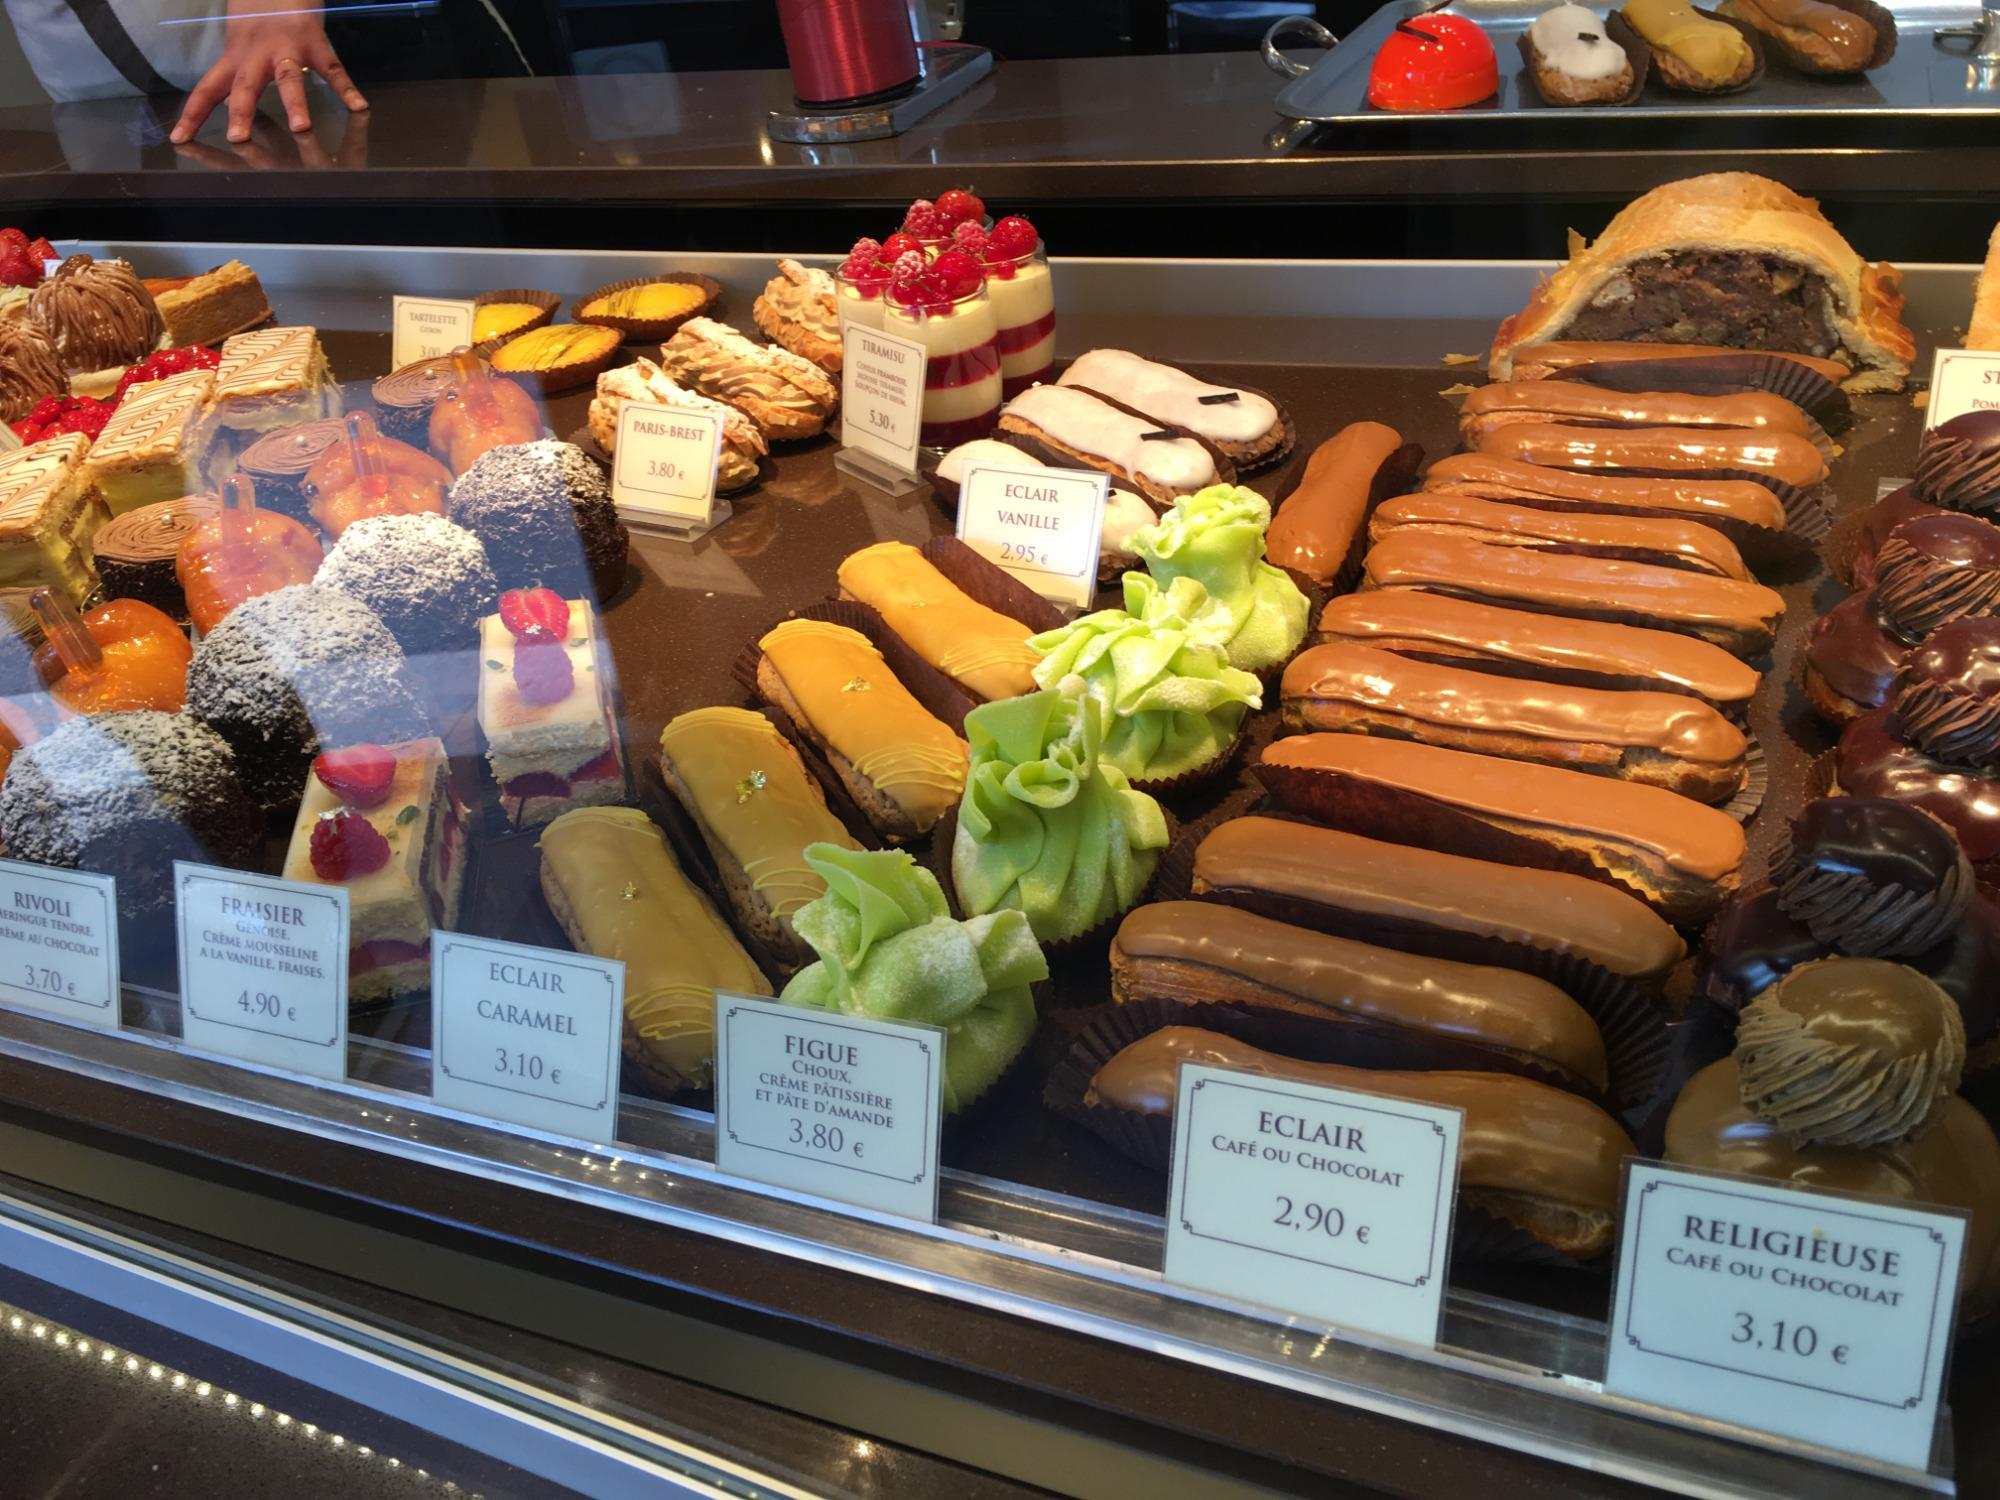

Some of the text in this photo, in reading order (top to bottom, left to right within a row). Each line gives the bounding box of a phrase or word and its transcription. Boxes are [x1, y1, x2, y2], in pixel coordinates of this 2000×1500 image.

[410, 312, 457, 325] TARTELETTE
[419, 345, 441, 358] 300
[862, 339, 905, 364] TIRAMISU
[633, 420, 705, 441] PARIS-BREST
[891, 423, 896, 433] €
[678, 470, 686, 480] €
[1005, 484, 1059, 503] ECLAIR
[997, 510, 1060, 530] VANILLE
[1041, 554, 1049, 565] €
[14, 891, 71, 917] RIVOLI
[221, 896, 305, 927] FRAISIER
[28, 934, 42, 945] AU
[44, 937, 100, 957] CHOCOLAT
[210, 948, 223, 960] LA
[244, 939, 319, 962] MOUSSELINE
[68, 982, 76, 996] €
[489, 962, 566, 994] ECLAIR
[288, 1007, 297, 1022] €
[477, 1000, 578, 1036] CARAMEL
[784, 1034, 858, 1067] FIGUE
[495, 1048, 561, 1085] 3,10 €
[792, 1060, 852, 1084] CHOUX,
[814, 1081, 893, 1110] PÂTISSIÈRE
[755, 1088, 894, 1129] ET PÂTE D'AMANDE
[789, 1118, 864, 1158] 3,80 €
[1258, 1111, 1367, 1153] ECLAIR
[1212, 1135, 1257, 1158] CAFÉ
[1296, 1152, 1404, 1188] CHOCOLAT
[1273, 1196, 1371, 1244] 2,90 €
[1683, 1215, 1901, 1278] RELIGIEUSE
[1666, 1247, 1722, 1273] CAFÉ
[1771, 1268, 1904, 1308] CHOCOLAT
[1731, 1311, 1850, 1366] 3,10 €
